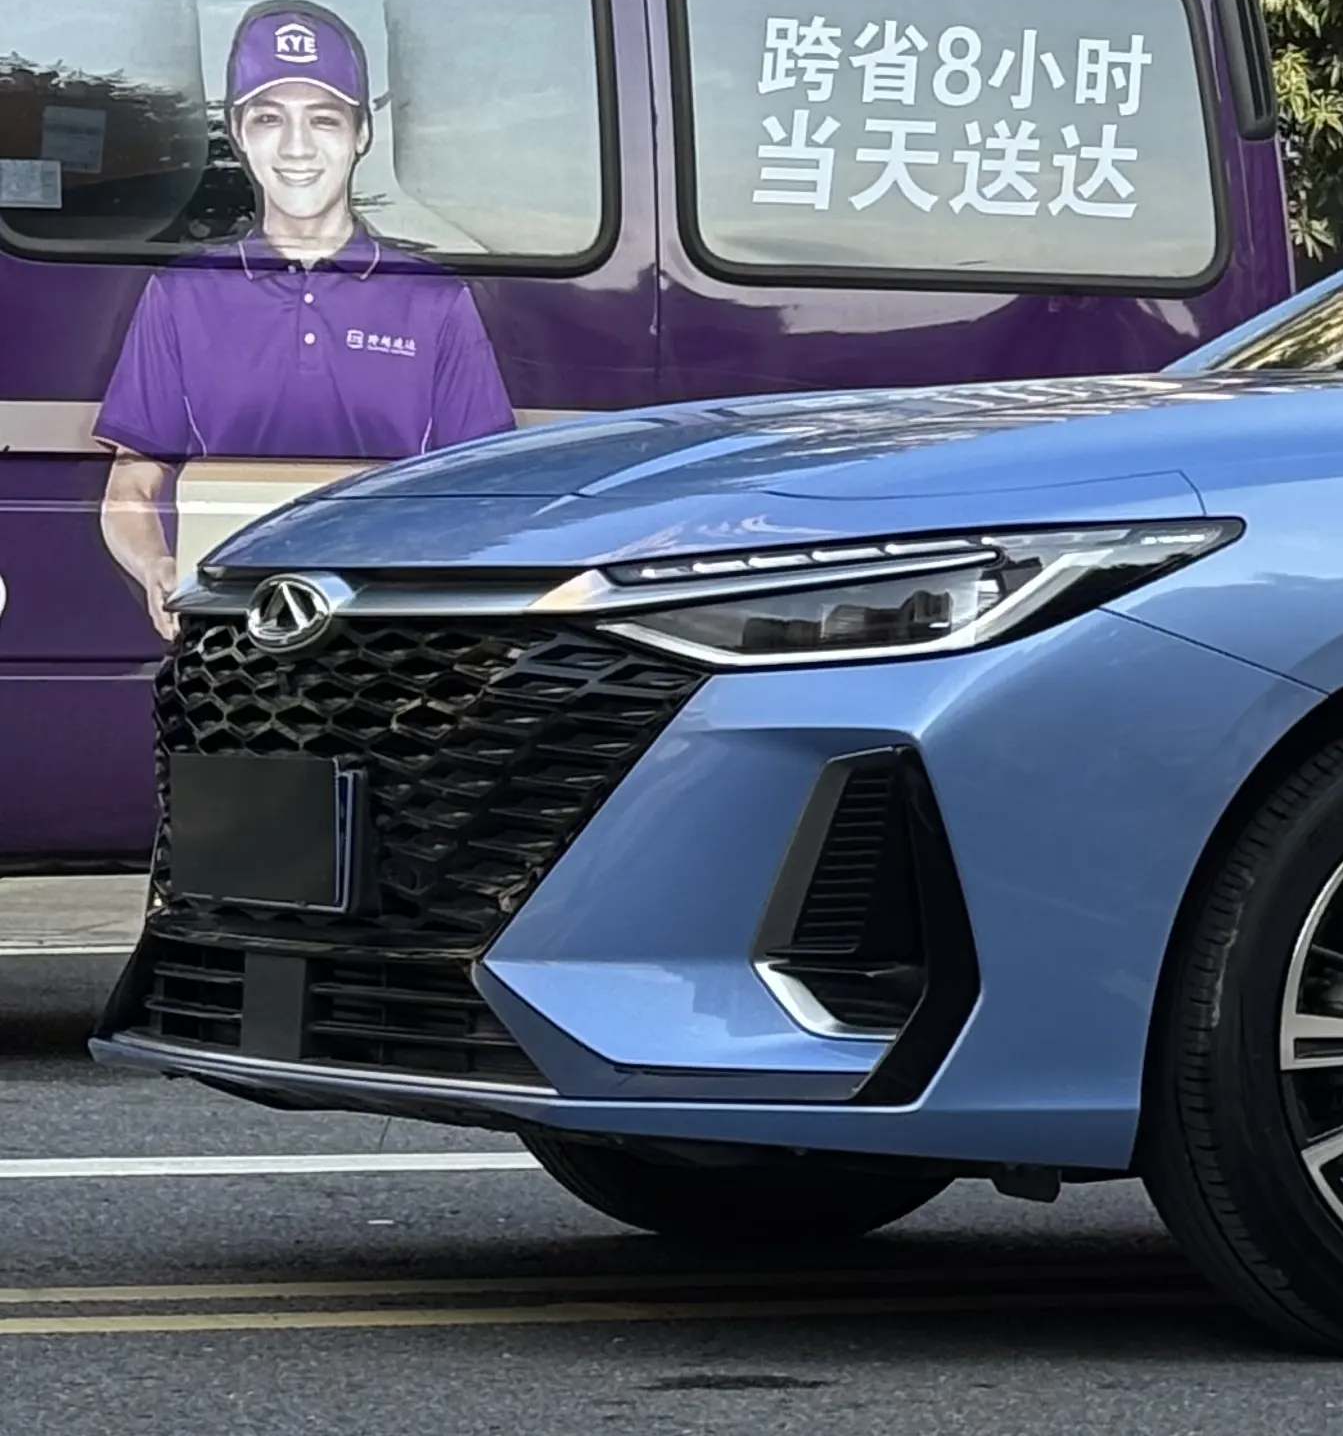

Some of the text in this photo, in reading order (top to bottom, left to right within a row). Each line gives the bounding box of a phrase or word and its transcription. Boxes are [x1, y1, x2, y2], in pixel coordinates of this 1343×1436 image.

[276, 34, 318, 54] KYE
[757, 15, 1153, 117] 跨省8小时
[752, 109, 1138, 219] 当天送达
